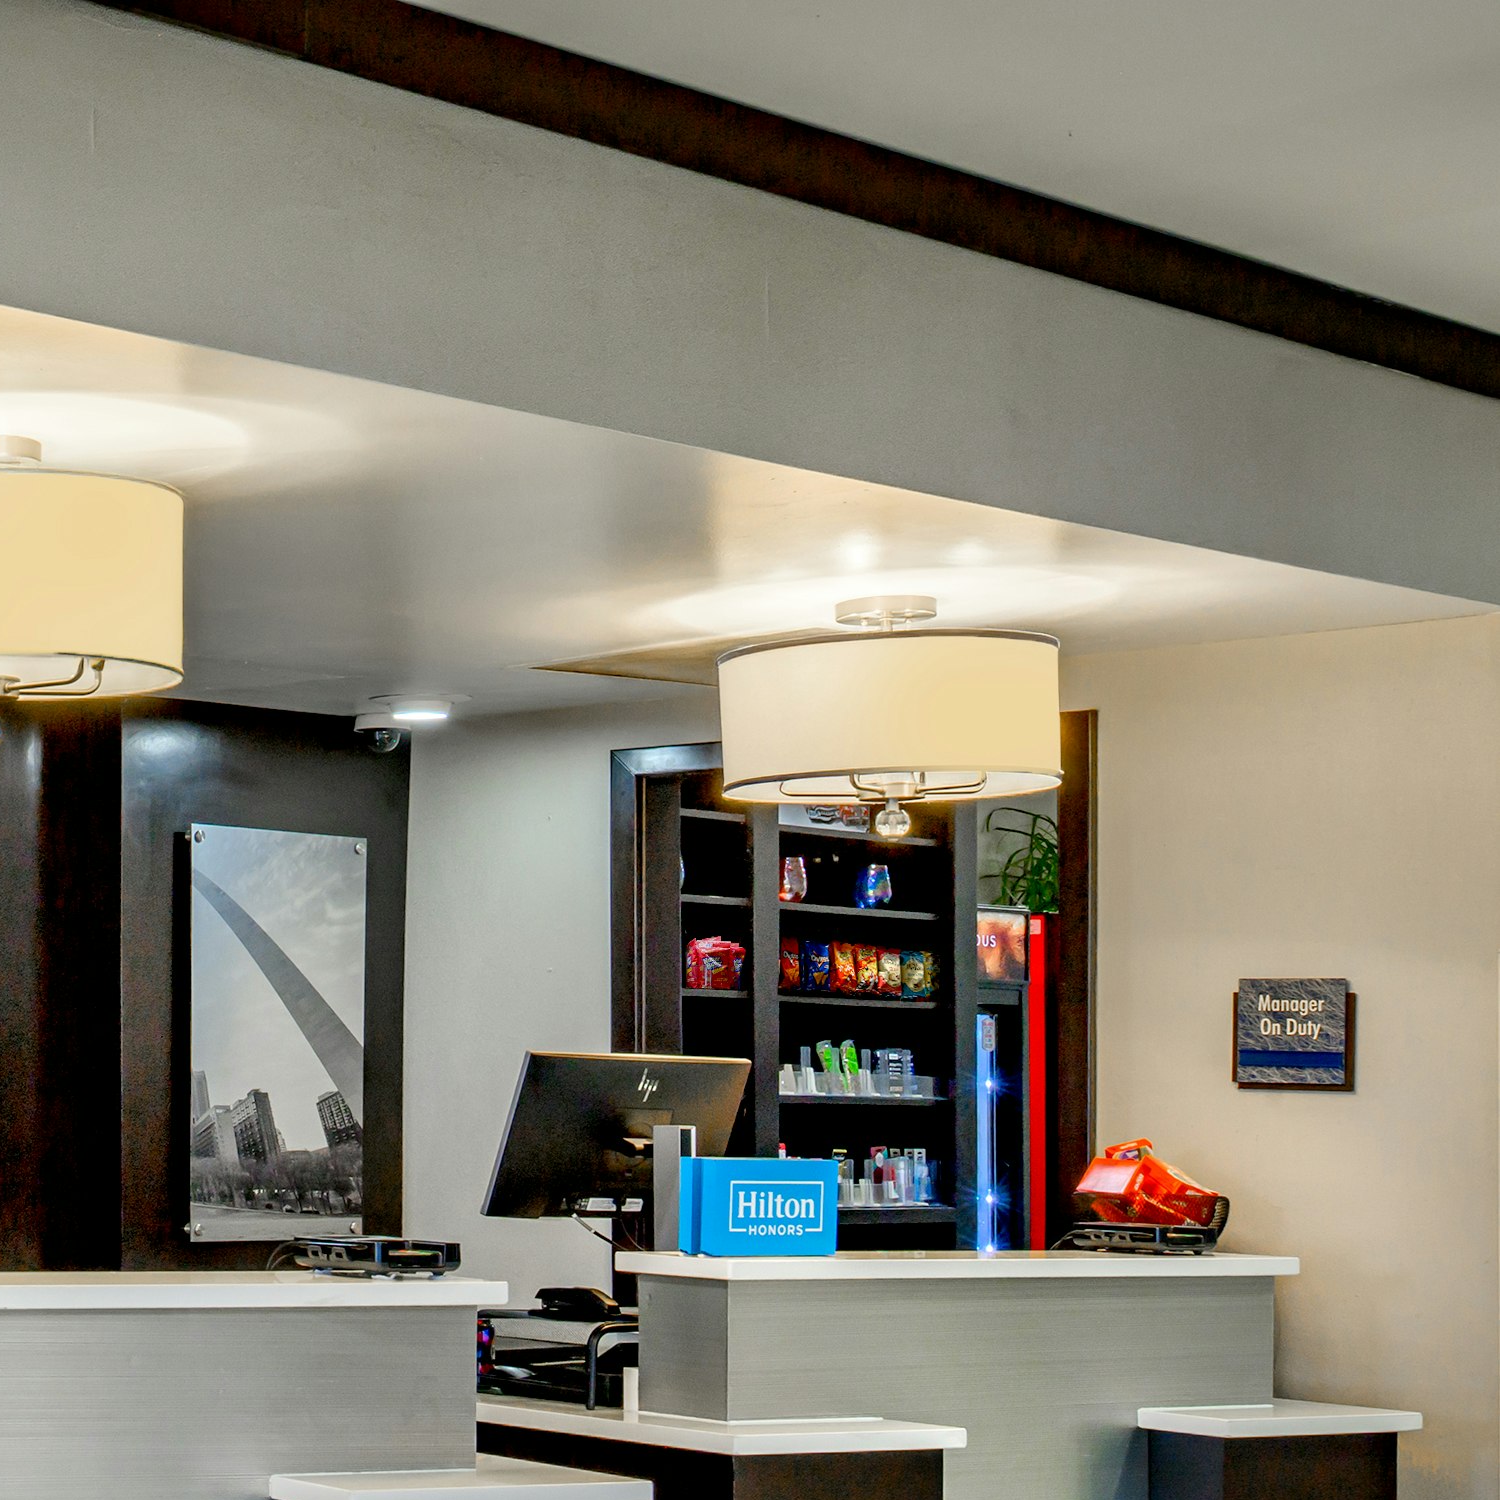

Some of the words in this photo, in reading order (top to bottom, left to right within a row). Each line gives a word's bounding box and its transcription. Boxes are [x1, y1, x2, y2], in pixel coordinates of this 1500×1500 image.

[1257, 994, 1325, 1016] Manager
[1260, 1018, 1281, 1035] On
[1286, 1018, 1321, 1040] Duty
[637, 1067, 660, 1103] hp
[737, 1191, 816, 1219] Hilton
[748, 1224, 804, 1236] HONORS
